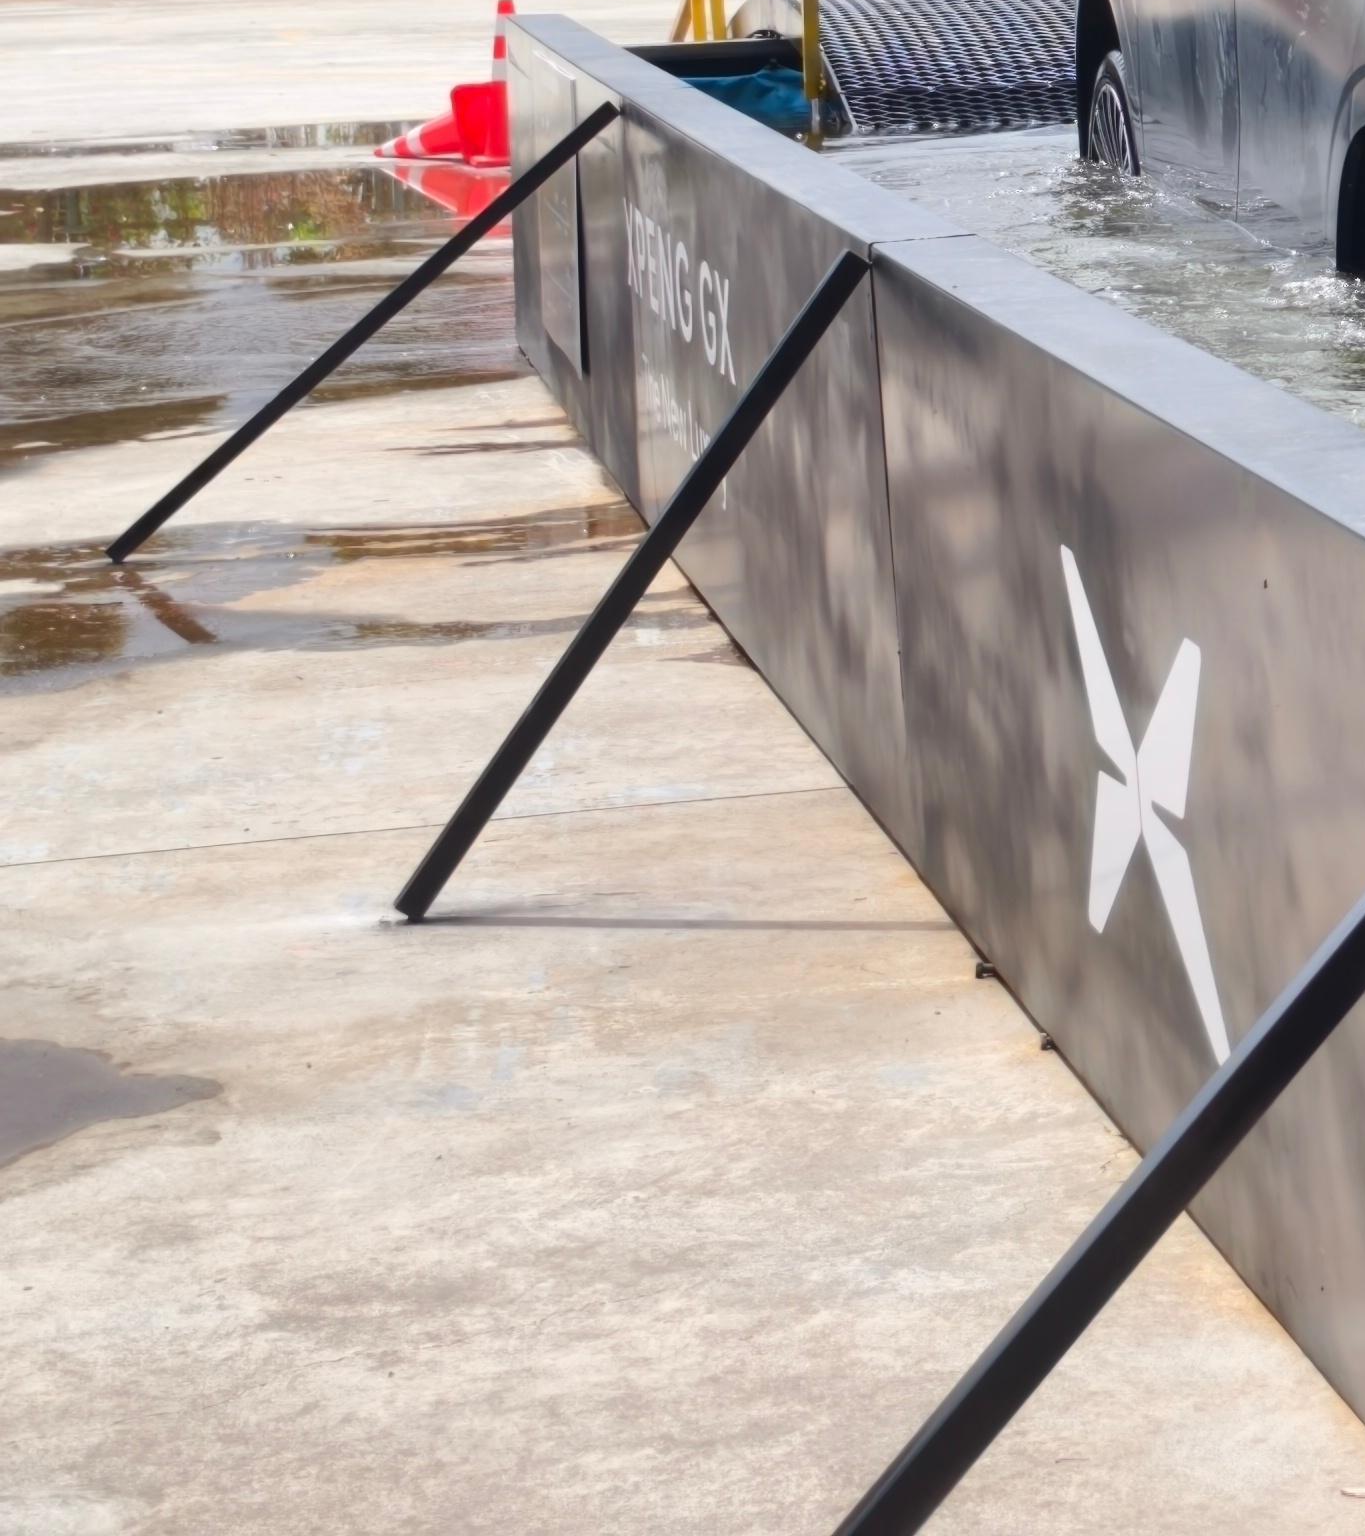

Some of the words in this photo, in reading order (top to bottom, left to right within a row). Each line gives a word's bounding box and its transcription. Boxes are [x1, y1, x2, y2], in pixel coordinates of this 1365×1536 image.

[623, 196, 693, 343] XPENG
[699, 260, 737, 386] GX
[641, 352, 662, 423] The
[660, 373, 688, 451] New
